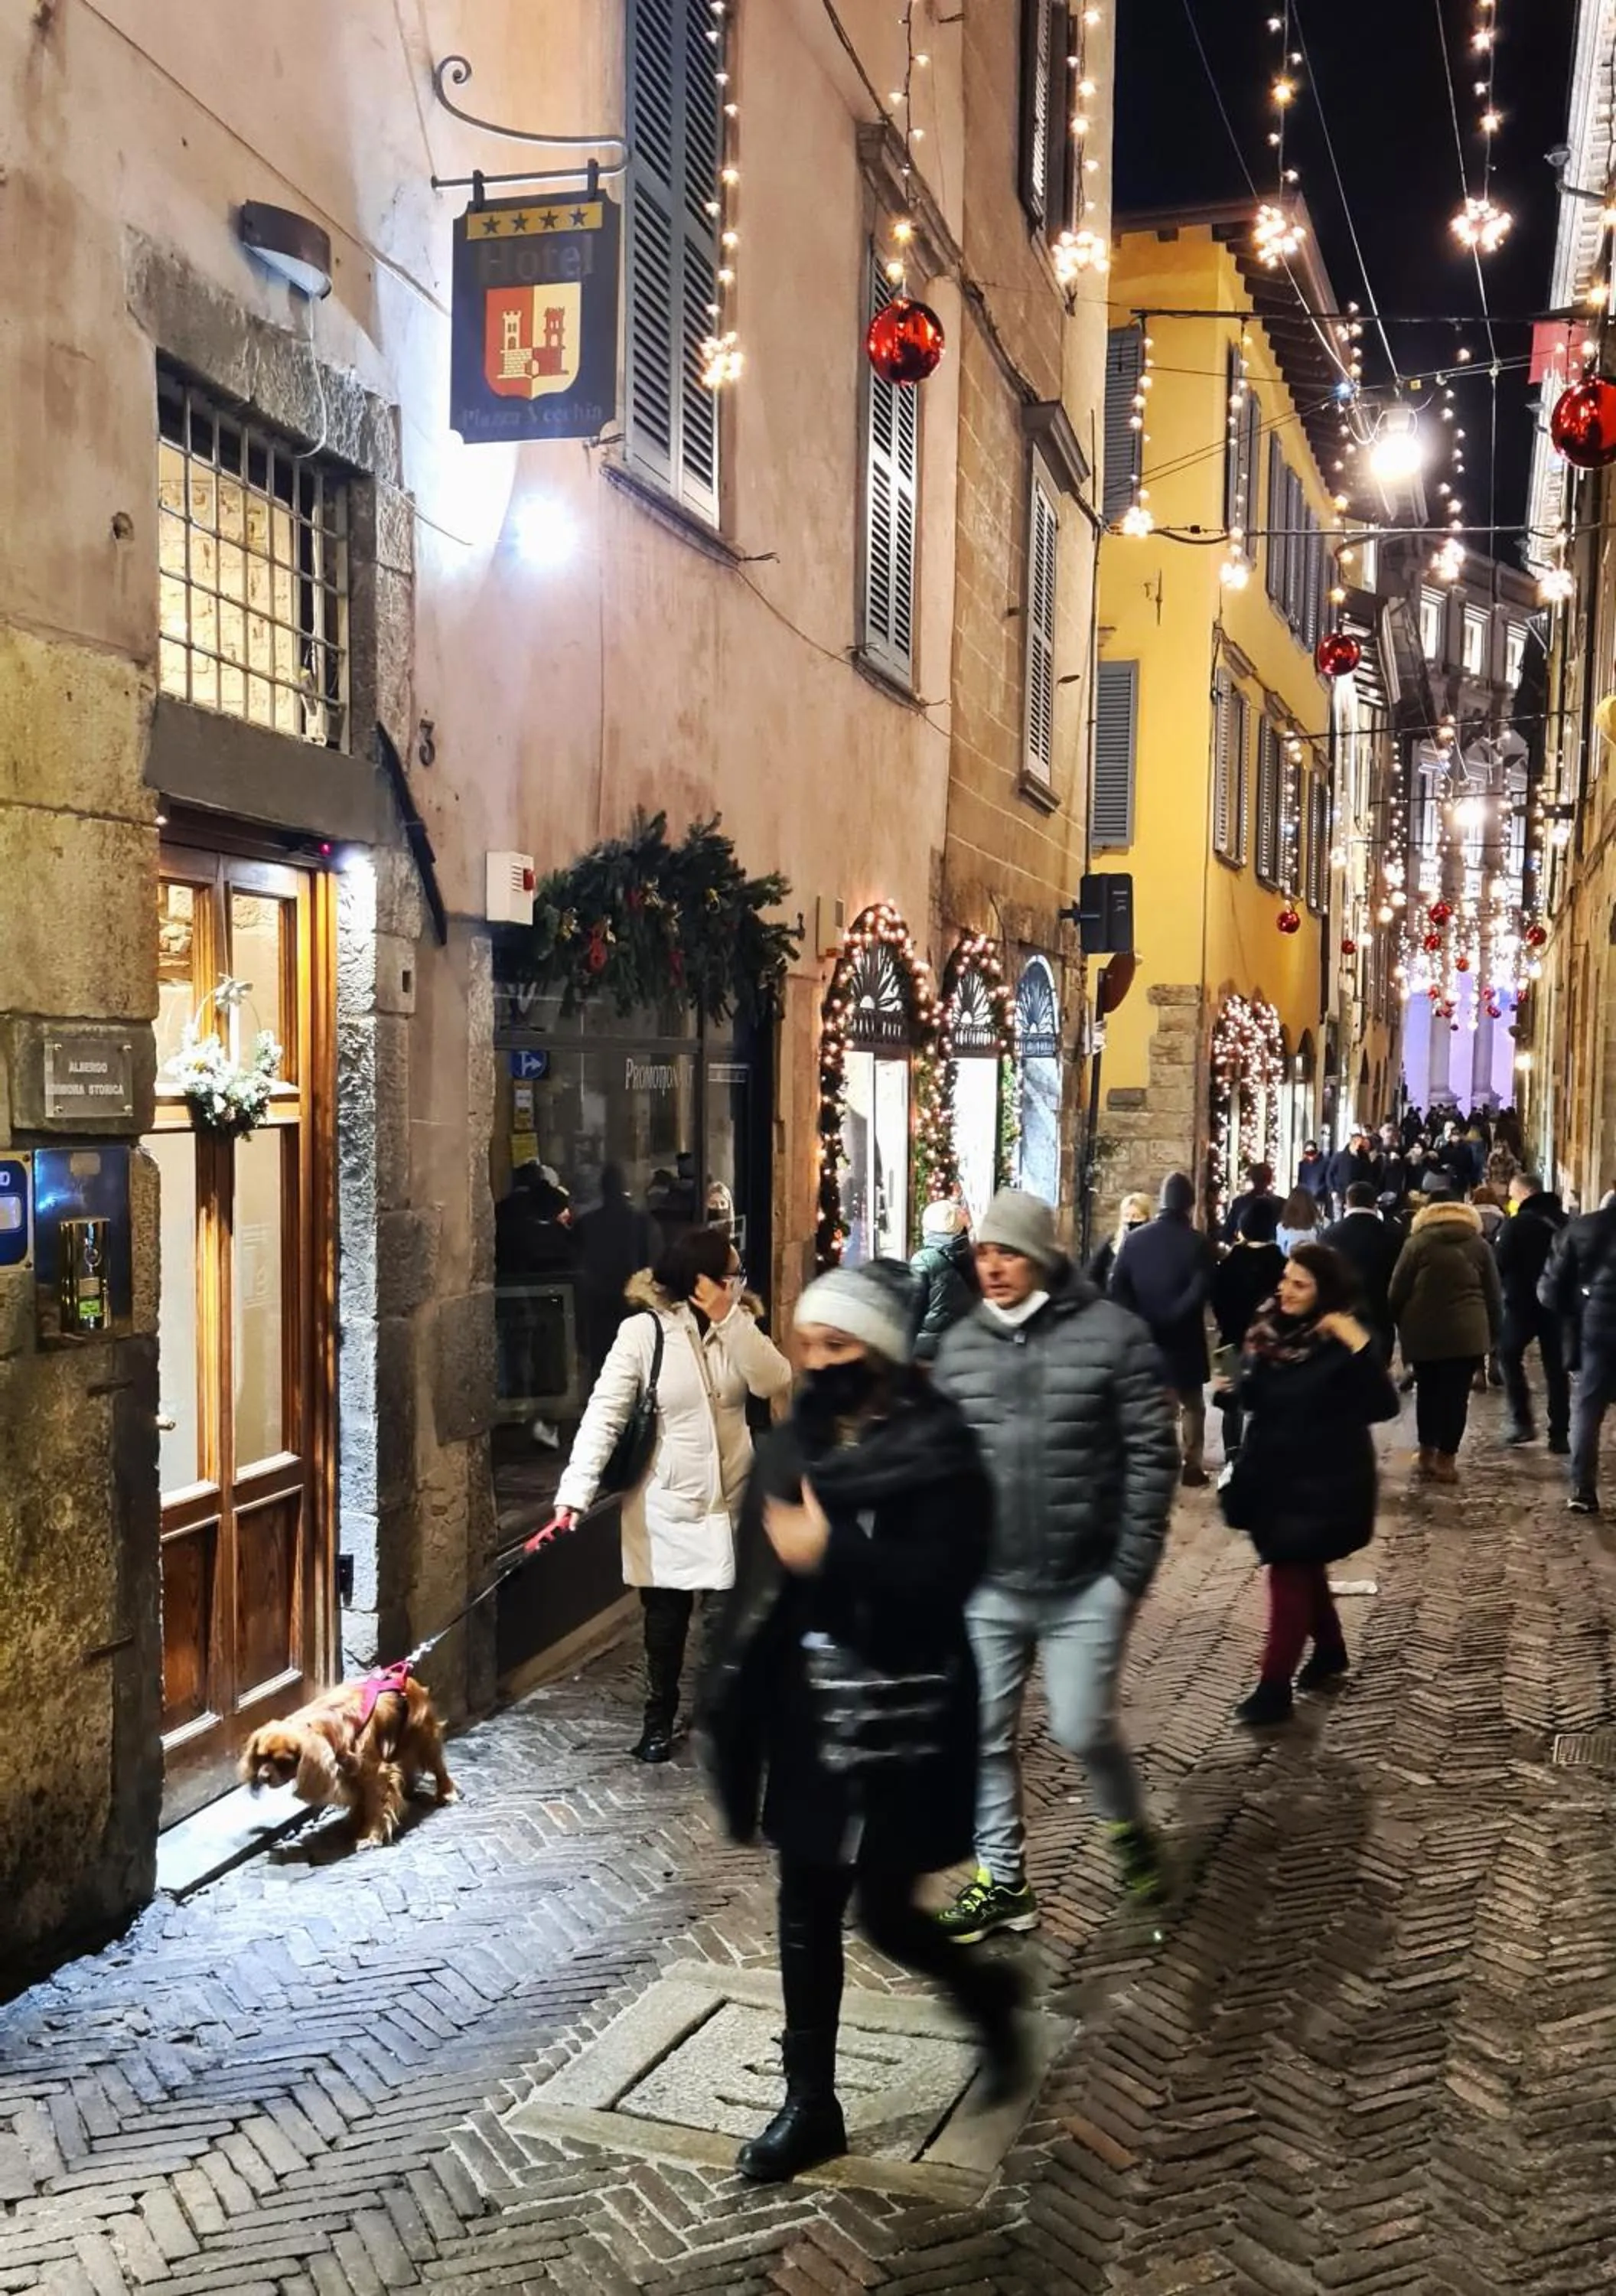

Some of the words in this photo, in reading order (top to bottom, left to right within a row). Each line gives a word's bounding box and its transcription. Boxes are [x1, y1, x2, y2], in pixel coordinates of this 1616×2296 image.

[477, 234, 594, 283] Hotel
[68, 1061, 108, 1073] ALBERGO
[88, 1084, 124, 1096] STORICA
